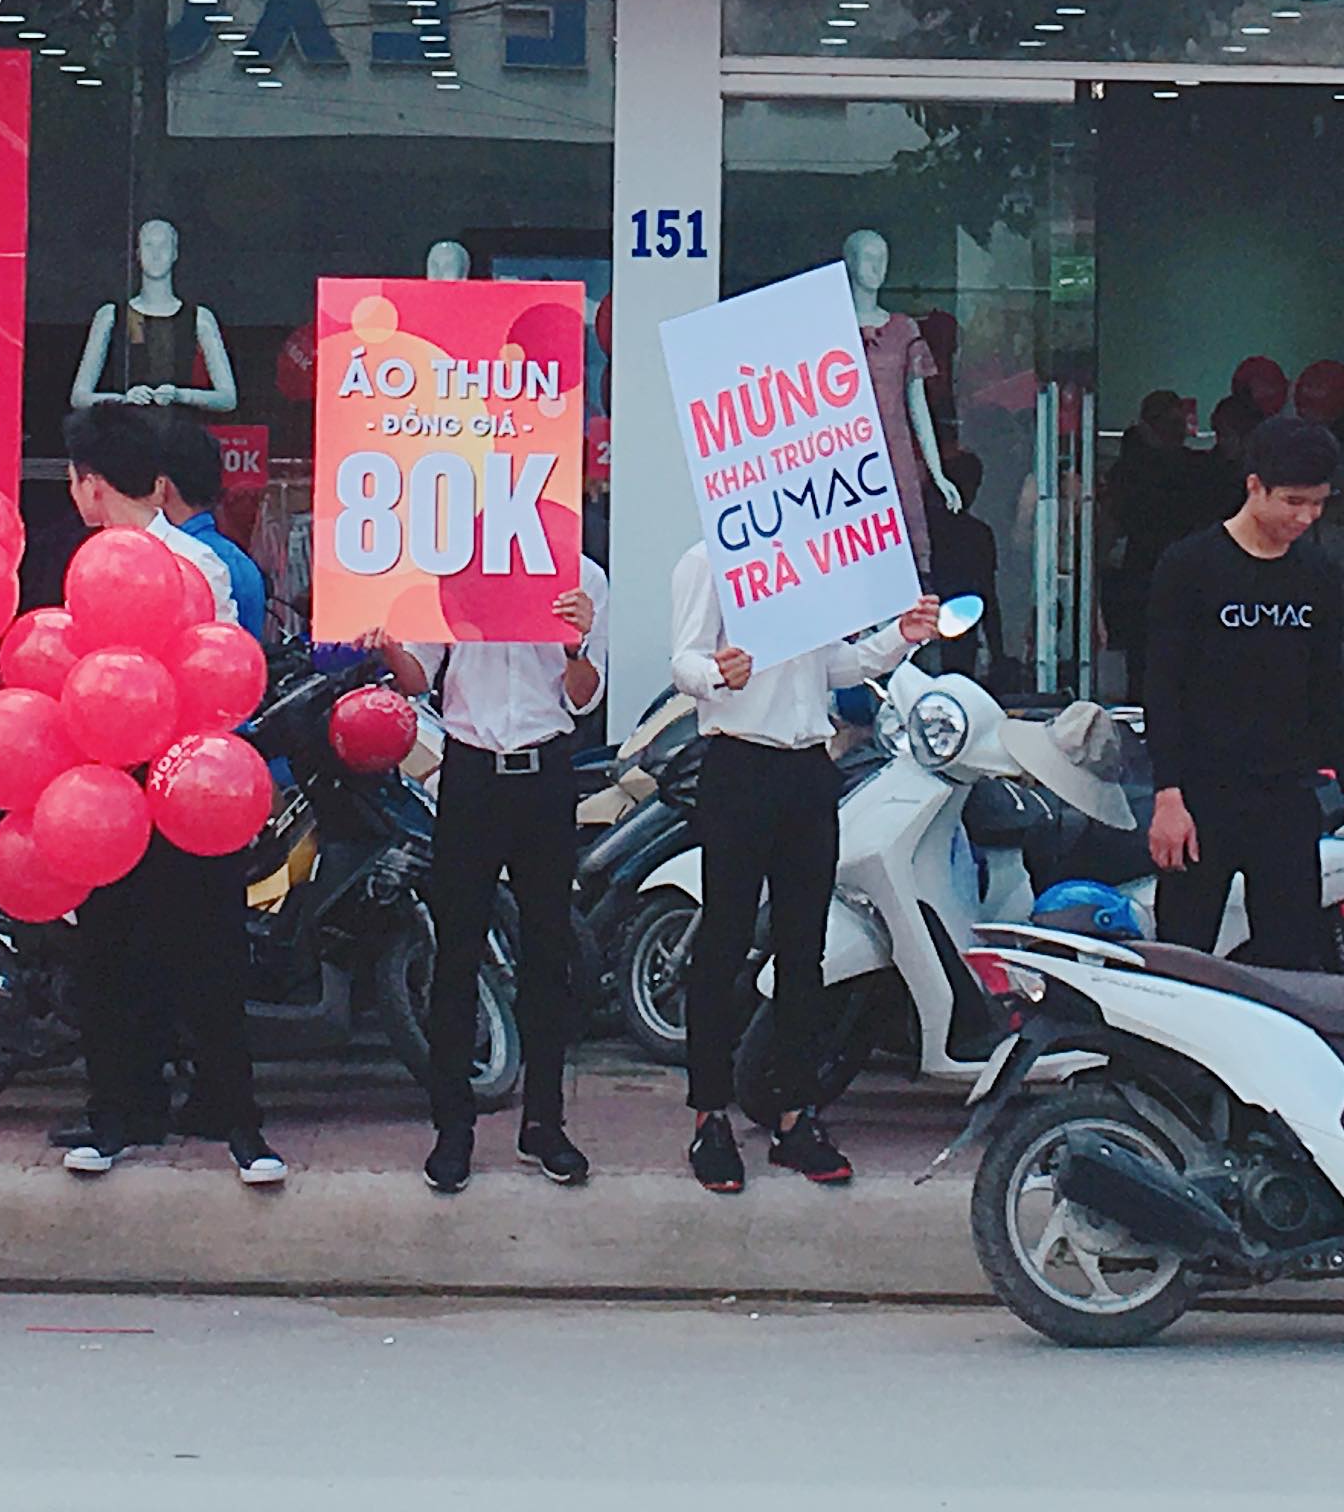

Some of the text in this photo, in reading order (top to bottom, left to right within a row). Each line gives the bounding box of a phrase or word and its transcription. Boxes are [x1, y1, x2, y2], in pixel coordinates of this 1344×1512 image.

[630, 209, 708, 259] 151
[337, 346, 562, 401] ÁO THUN
[688, 349, 860, 459] MỪNG
[382, 403, 517, 439] ĐỒNG GIÁ
[703, 416, 874, 501] KHAI TRƯƠNG
[333, 450, 561, 577] 80K
[716, 450, 889, 552] GUMAC
[725, 506, 905, 609] TRÀ VINH
[1219, 603, 1313, 628] GUMAC
